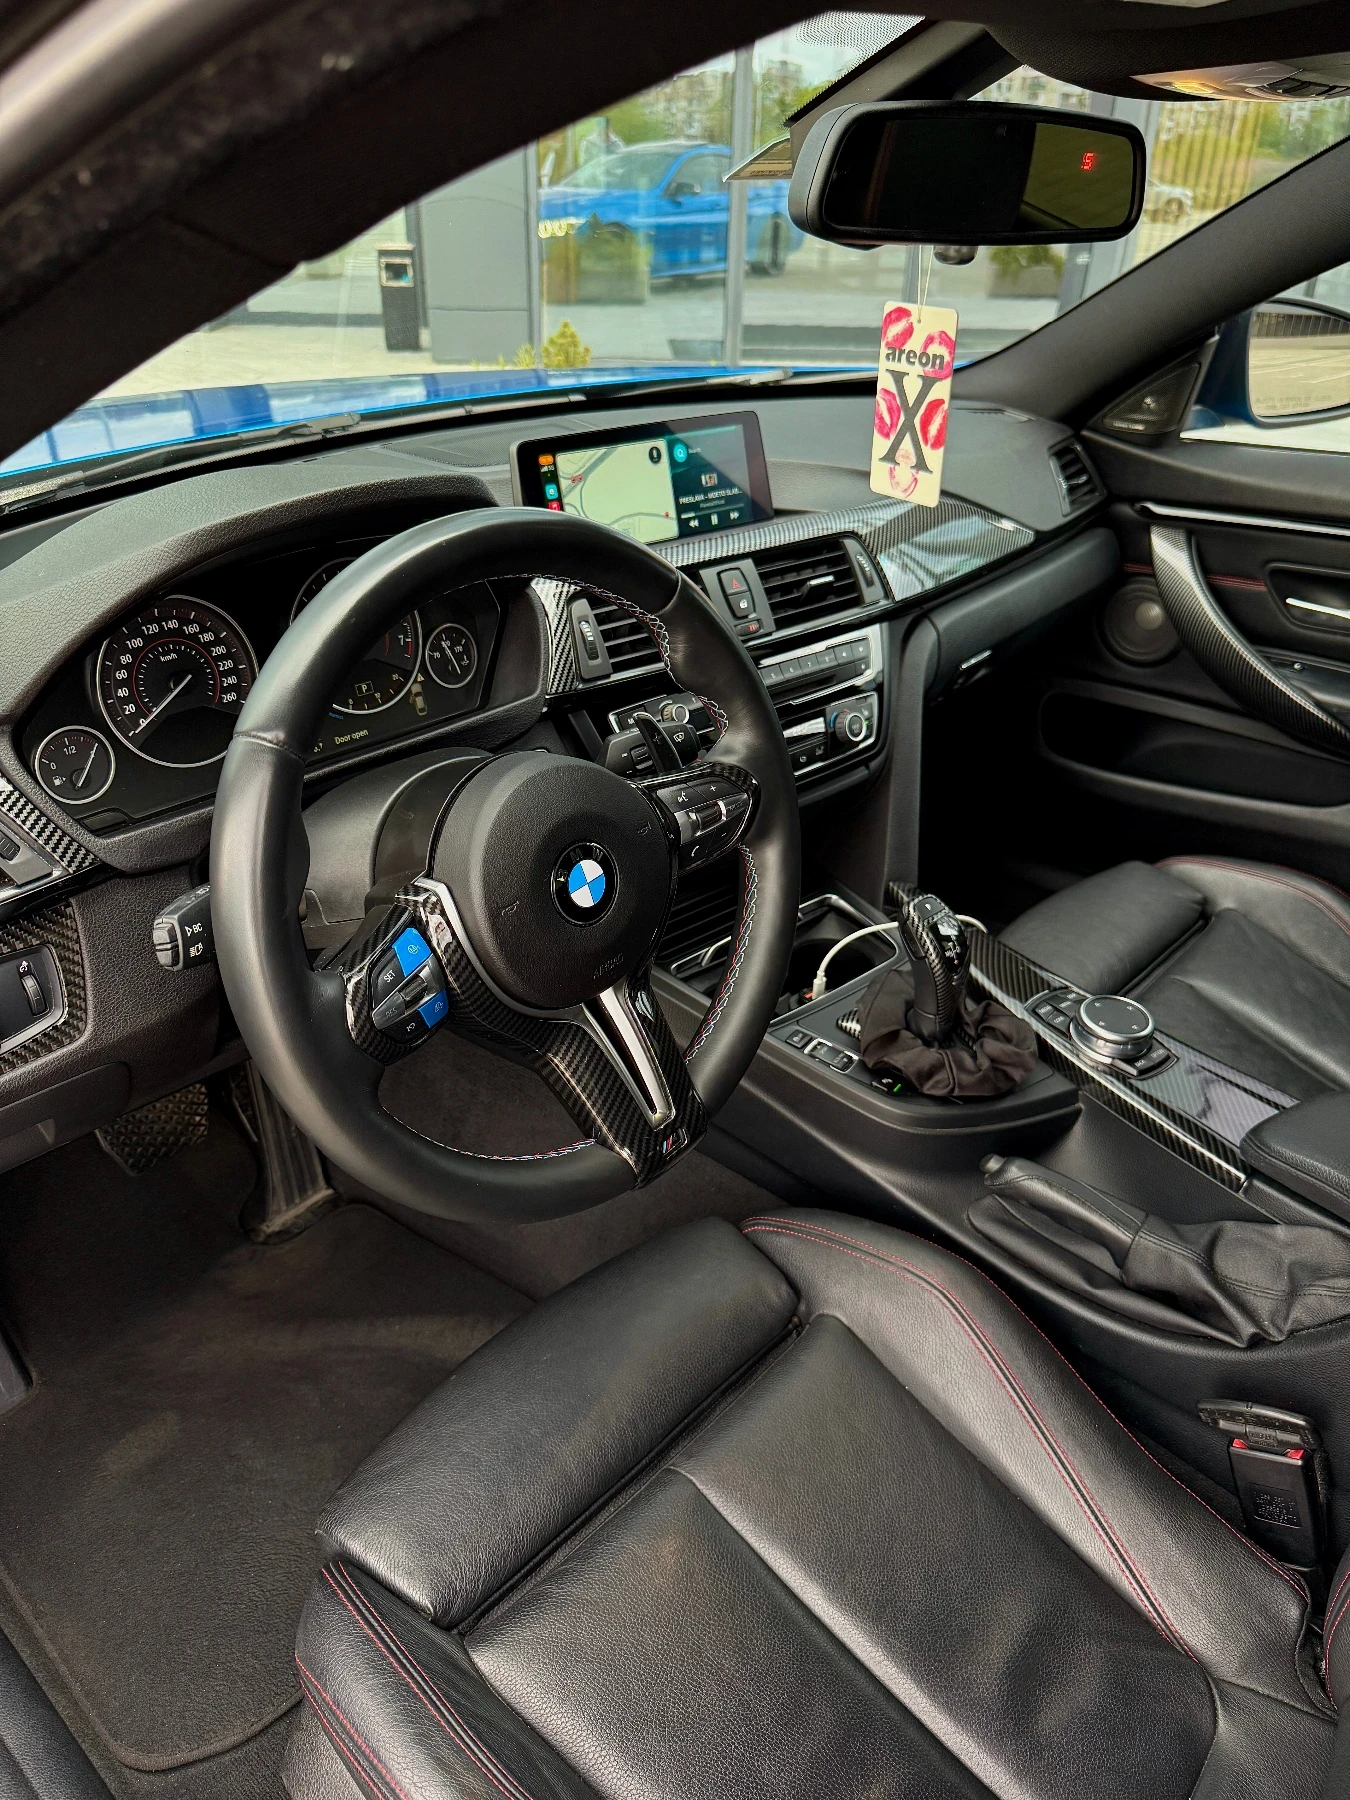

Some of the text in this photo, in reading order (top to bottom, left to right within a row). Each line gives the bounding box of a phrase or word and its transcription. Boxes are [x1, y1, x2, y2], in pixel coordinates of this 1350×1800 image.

[885, 346, 945, 371] areon
[879, 369, 943, 475] X
[141, 623, 159, 636] 120
[161, 619, 179, 631] 140
[182, 623, 200, 635] 160
[198, 631, 215, 643] 180
[126, 637, 144, 650] 100
[210, 645, 227, 657] 200
[120, 653, 133, 665] 80
[160, 652, 178, 663] km/h
[217, 659, 234, 671] 220
[115, 669, 128, 680] 60
[221, 675, 238, 687] 240
[117, 687, 129, 698] 40
[362, 684, 368, 694] P
[221, 692, 238, 704] 260
[123, 703, 136, 715] 20
[334, 729, 369, 745] Door open
[63, 745, 77, 756] 1/2
[50, 762, 57, 770] 0
[193, 922, 203, 933] BC
[384, 969, 396, 983] SET
